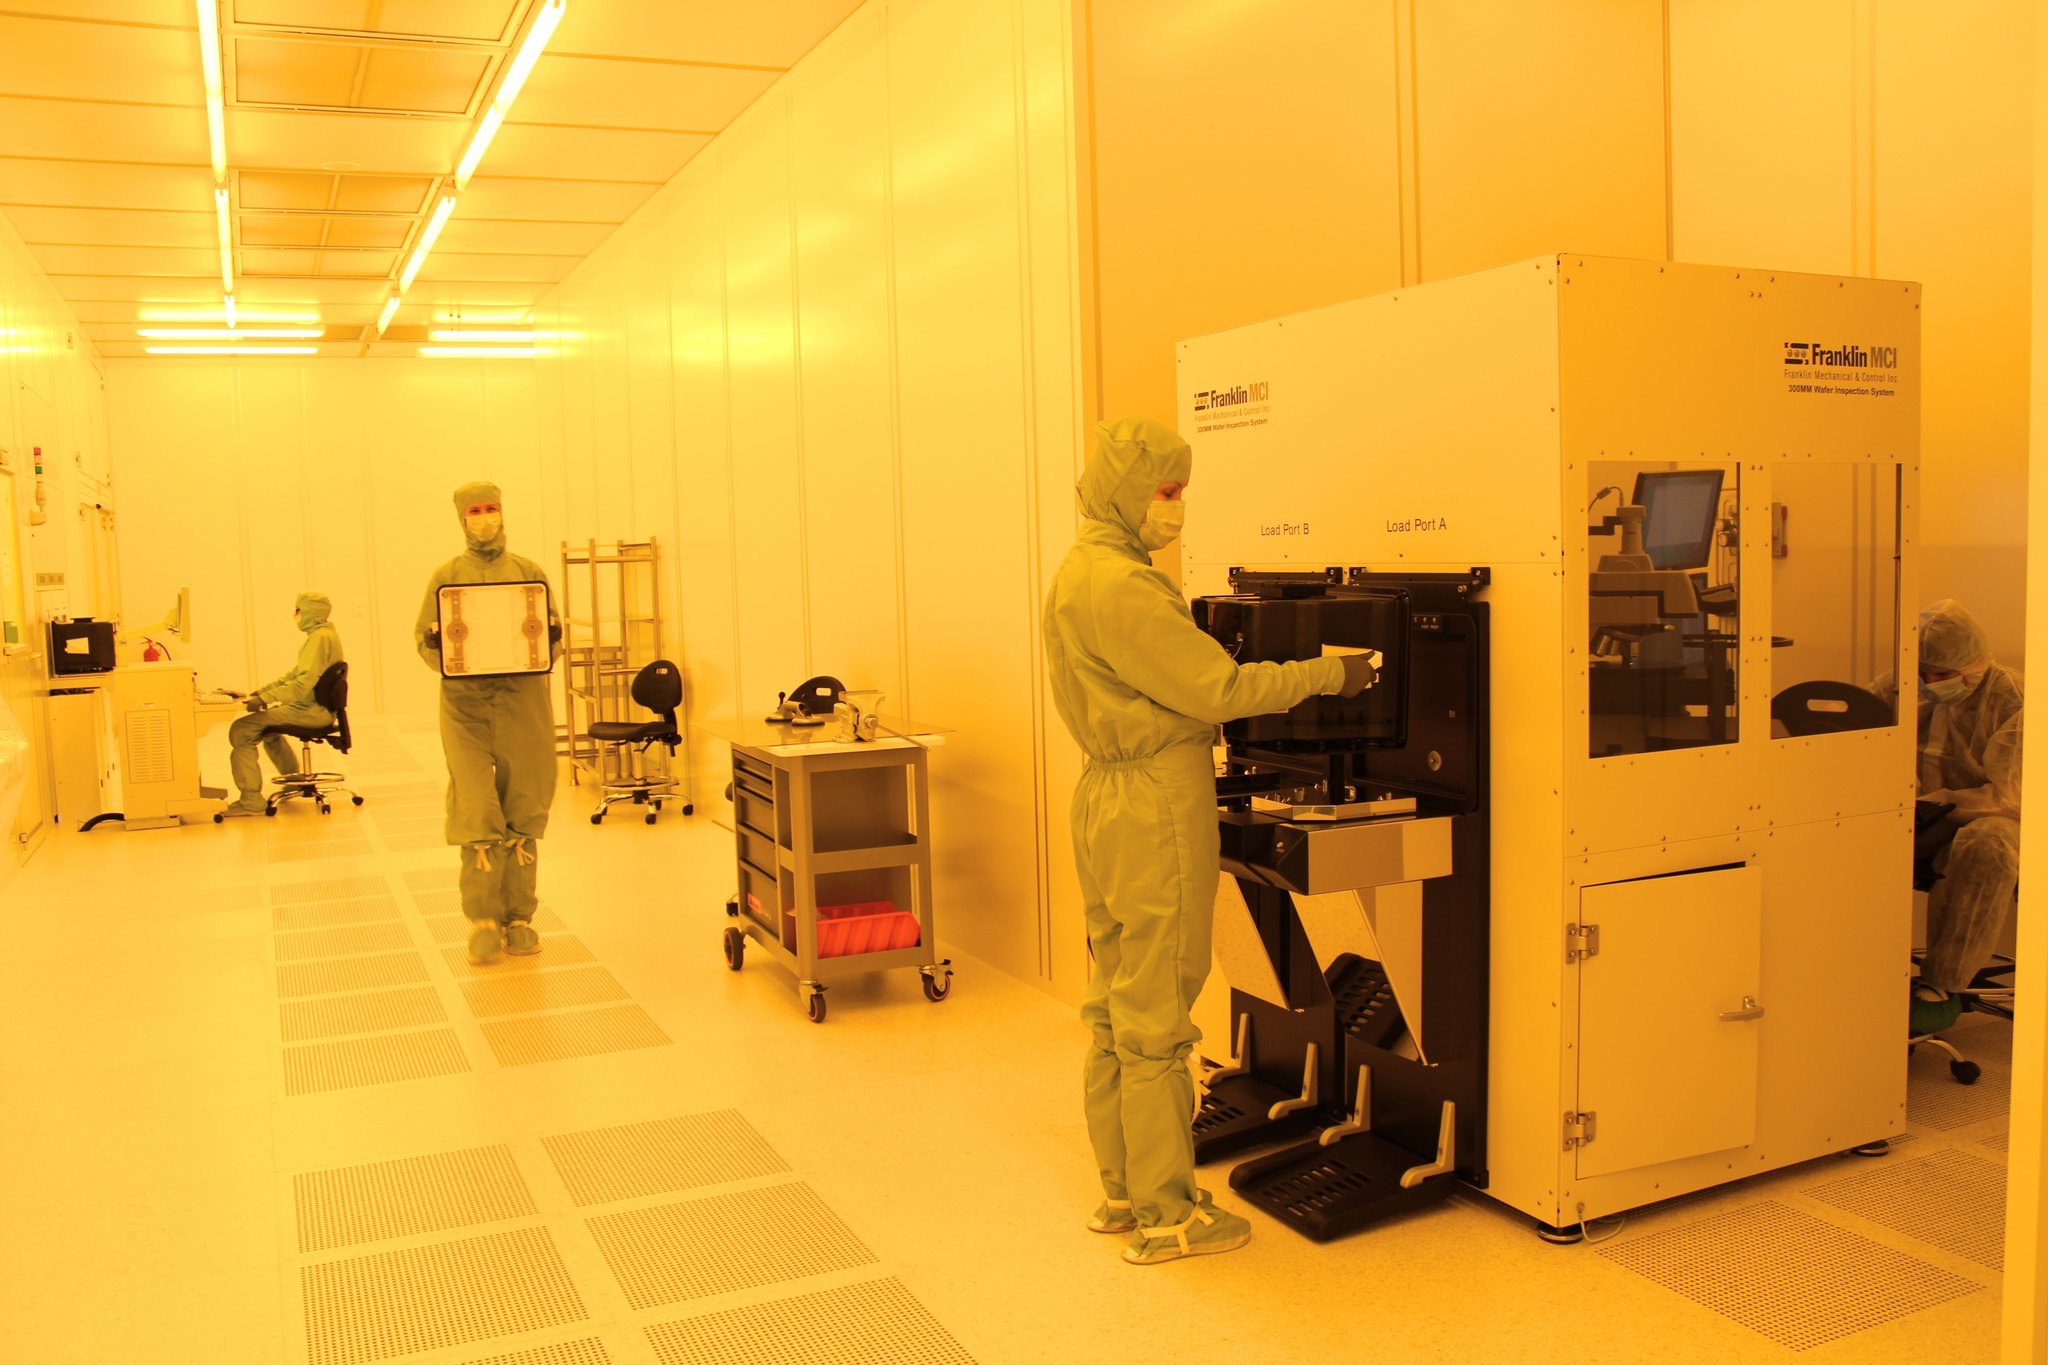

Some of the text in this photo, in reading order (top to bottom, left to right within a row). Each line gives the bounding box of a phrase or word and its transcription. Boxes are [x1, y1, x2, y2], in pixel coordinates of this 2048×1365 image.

[1812, 344, 1897, 369] Franklin MCI
[1784, 369, 1812, 379] Franklin
[1815, 370, 1853, 381] Mechanical
[1855, 372, 1860, 382] &
[1862, 372, 1885, 382] Control
[1211, 381, 1269, 408] Franklin MCI
[1788, 384, 1895, 397] 300MM Wafer Inspection System
[1261, 522, 1310, 536] Load Port B
[1386, 517, 1447, 533] Load Port A
